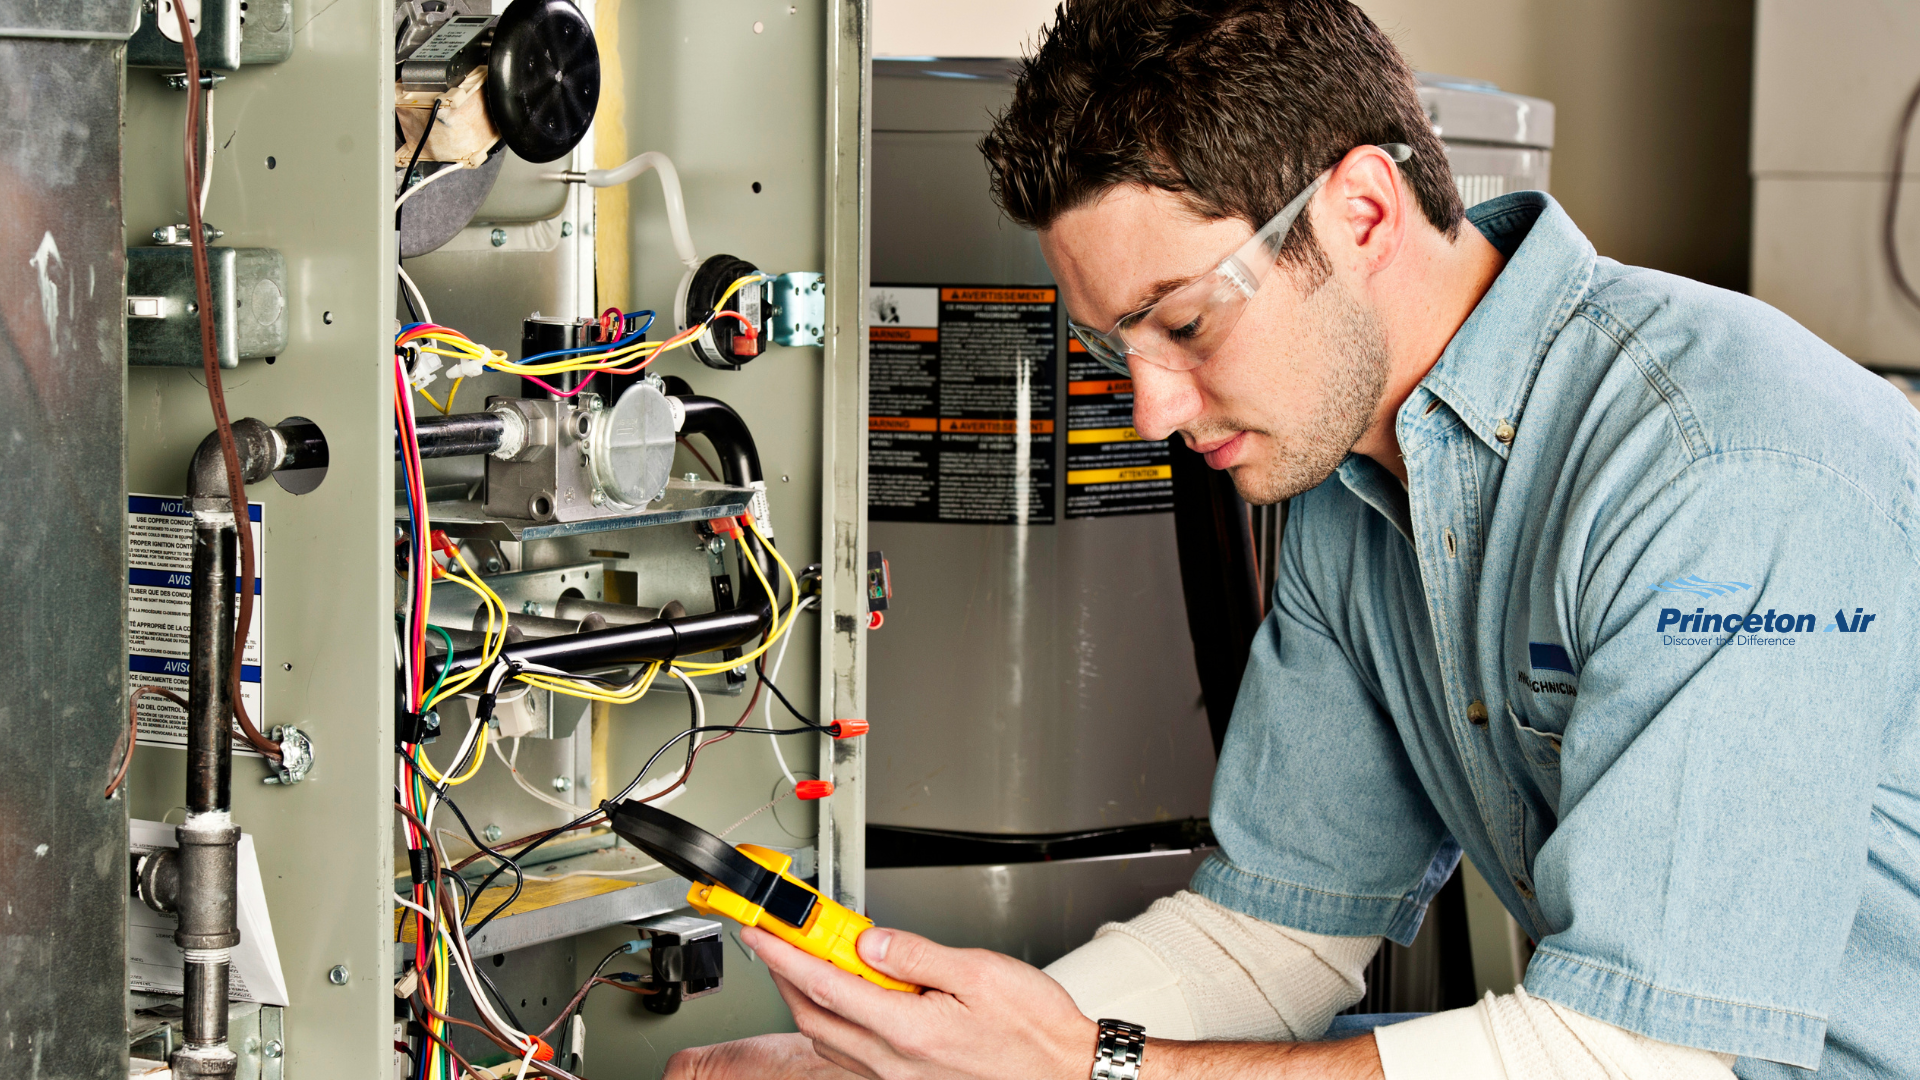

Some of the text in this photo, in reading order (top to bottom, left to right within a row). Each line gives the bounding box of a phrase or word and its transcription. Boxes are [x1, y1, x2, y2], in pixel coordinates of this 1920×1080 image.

[962, 292, 1046, 300] AVERTISSEMENT
[960, 422, 1044, 430] AVERTISSENT
[1119, 469, 1159, 479] ATTENTION
[130, 539, 152, 547] PROPER
[137, 622, 166, 630] APPROPRIÉ
[139, 674, 172, 683] ÚNICAMENTE
